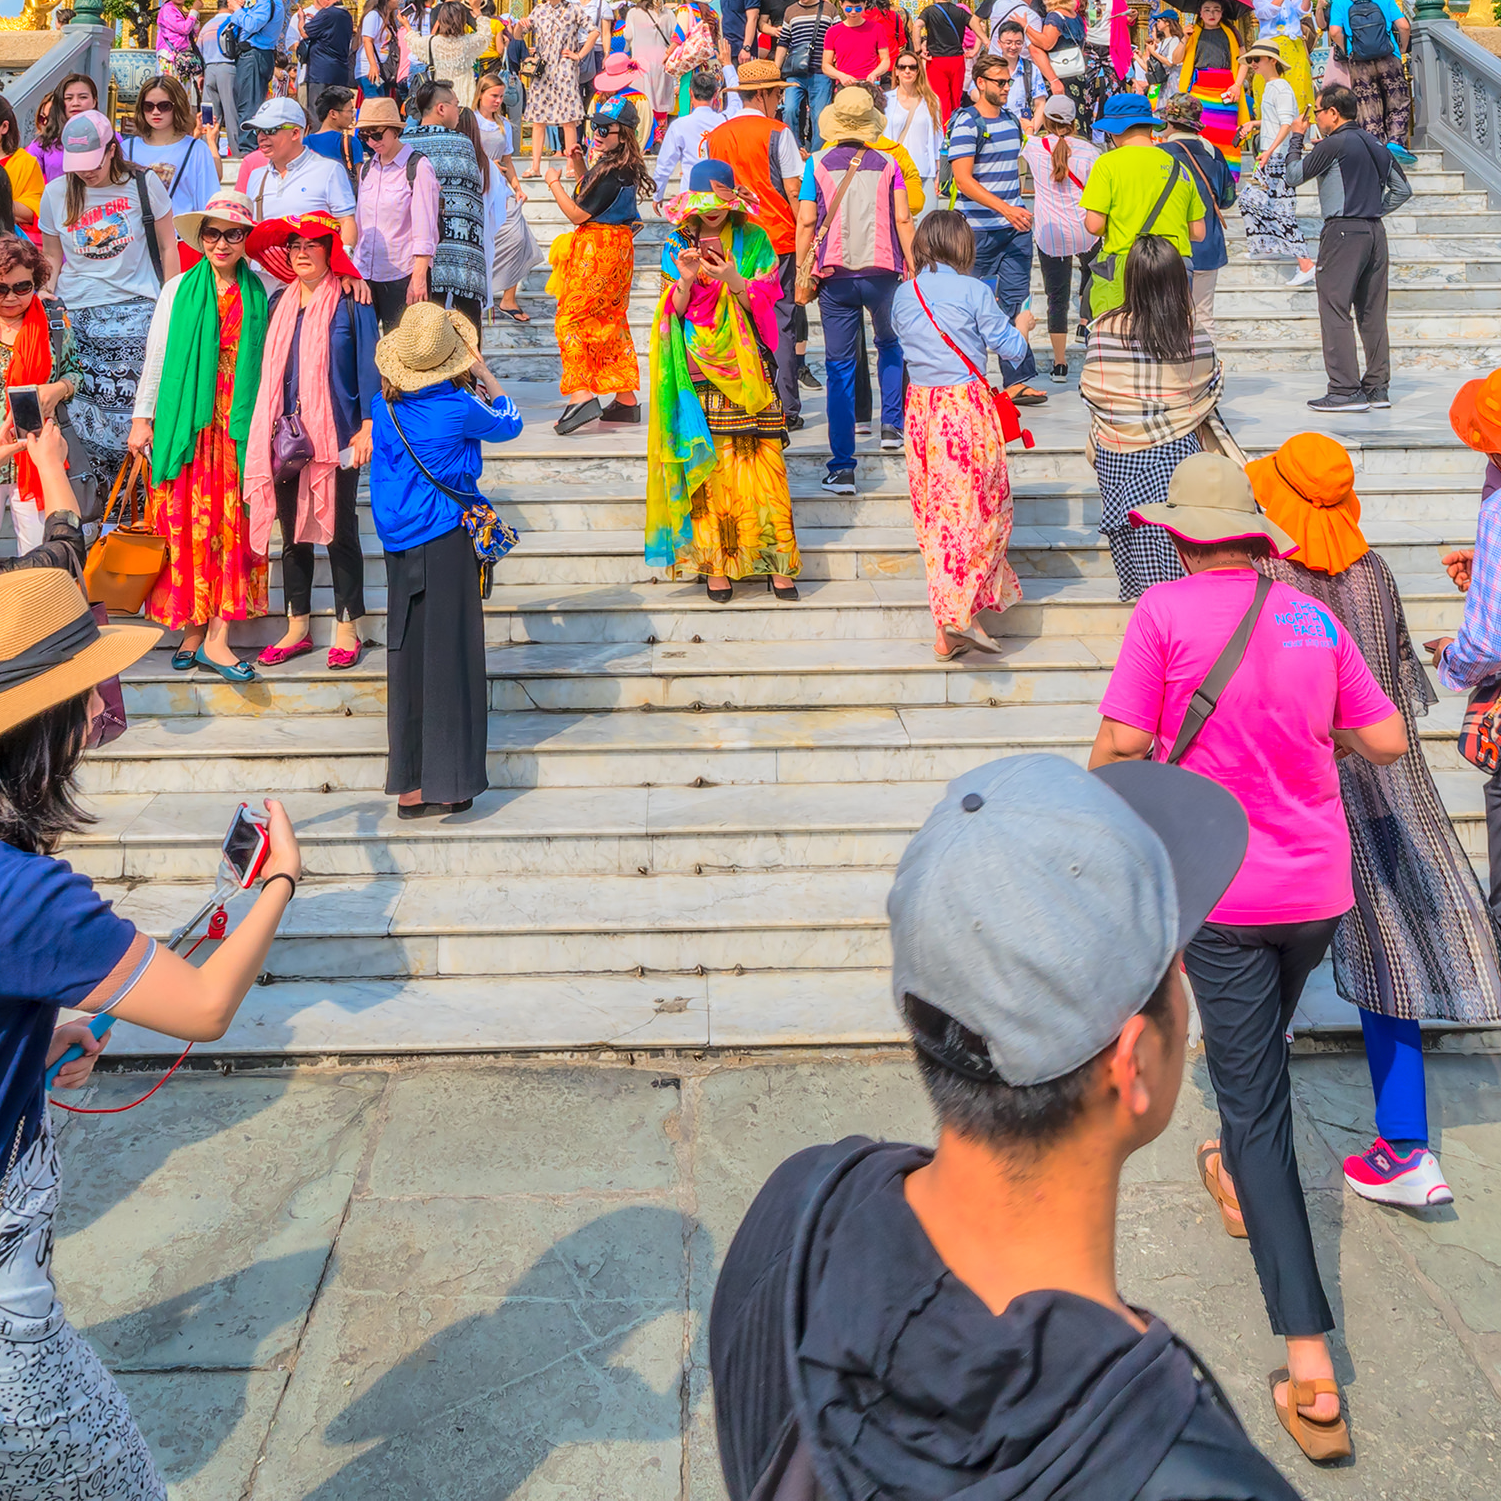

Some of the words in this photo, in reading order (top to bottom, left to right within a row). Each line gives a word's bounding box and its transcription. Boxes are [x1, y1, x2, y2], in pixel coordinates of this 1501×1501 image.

[105, 197, 132, 217] GIRL
[1290, 602, 1311, 613] THE
[1274, 612, 1321, 626] NORTH
[1293, 624, 1324, 637] FACE
